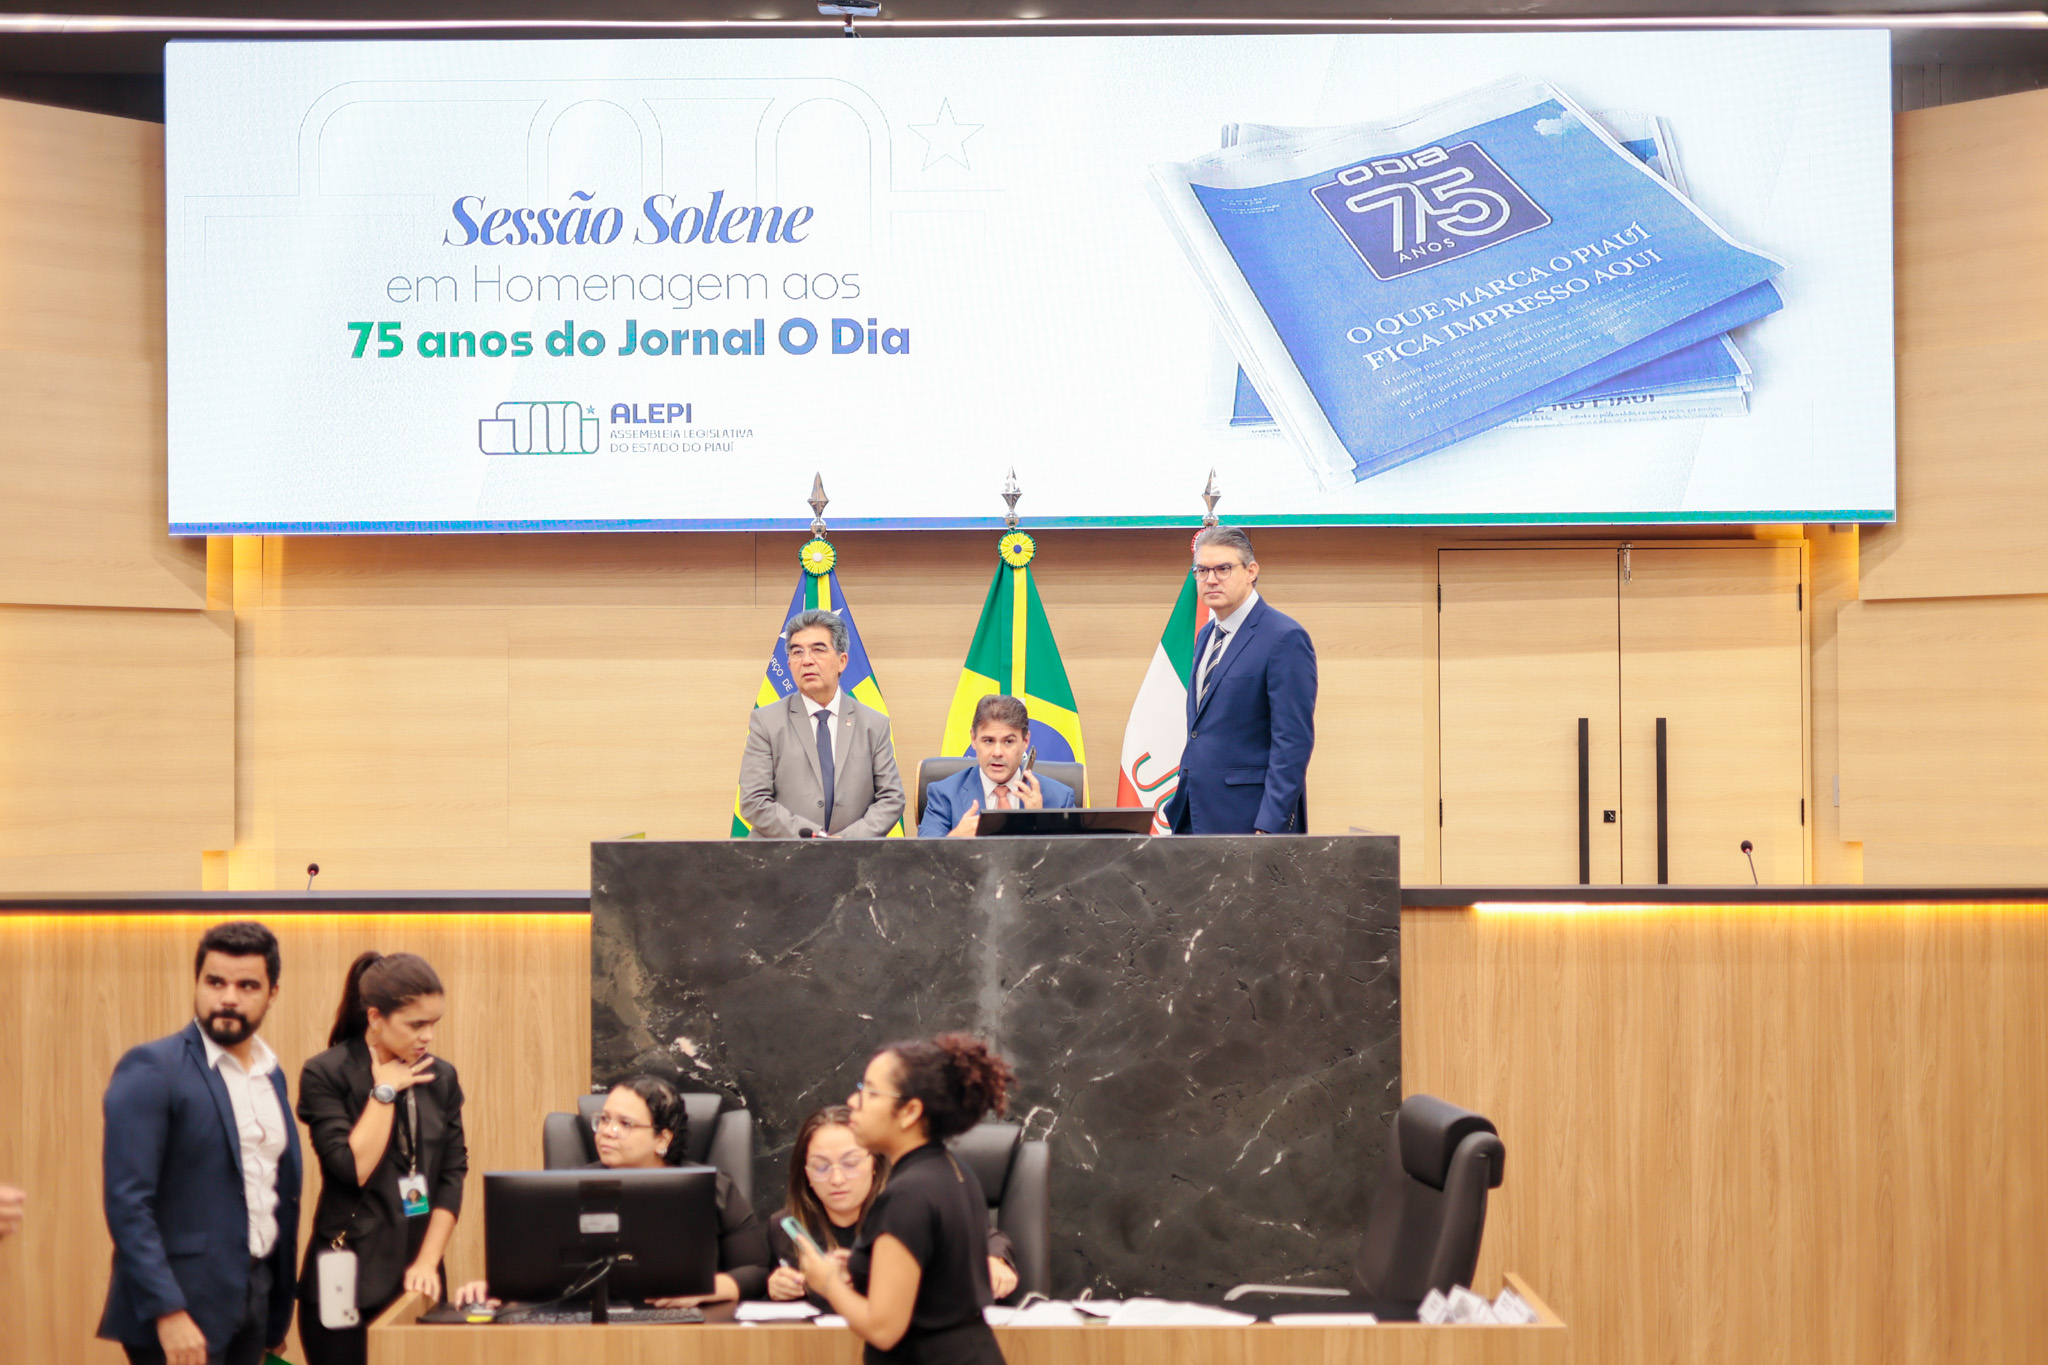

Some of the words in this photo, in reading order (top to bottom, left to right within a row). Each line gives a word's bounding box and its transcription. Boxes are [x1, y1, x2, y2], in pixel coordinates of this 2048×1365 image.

[442, 191, 623, 246] Sessão
[633, 190, 813, 244] Solene
[1345, 166, 1511, 252] 75
[1399, 237, 1457, 263] ANOS
[387, 276, 457, 303] em
[475, 265, 767, 309] Homenagem
[783, 272, 860, 300] aos
[1346, 327, 1373, 344] O
[1375, 301, 1446, 335] QUE
[1442, 266, 1554, 311] MARCA
[1549, 256, 1573, 272] O
[1570, 220, 1653, 264] PIAUÍ
[1362, 333, 1445, 370] FICA
[1441, 277, 1590, 340] IMPRESSO
[1593, 248, 1664, 285] AQUI
[348, 322, 403, 358] 75
[417, 331, 533, 358] anos
[546, 320, 605, 356] do
[619, 319, 764, 356] Jornal
[779, 318, 818, 355] O
[832, 318, 909, 354] Dia
[1392, 368, 1422, 381] tempo
[1468, 341, 1489, 353] pode
[1408, 405, 1431, 420] para
[1432, 397, 1449, 409] que
[1459, 376, 1500, 397] memória
[1501, 371, 1513, 379] do
[1514, 359, 1540, 374] nosso
[1540, 350, 1562, 363] povo
[1414, 391, 1428, 401] ser
[1438, 371, 1479, 392] guardião
[1480, 366, 1492, 374] da
[610, 403, 691, 423] ALEPI
[610, 429, 680, 439] ASSEMBLEIA
[683, 429, 754, 438] LEGISLATIVA
[610, 443, 629, 453] DO
[632, 442, 678, 453] ESTADO
[682, 442, 702, 453] DO
[704, 441, 734, 452] PIAUÍ
[770, 654, 784, 677] RÇO
[782, 678, 794, 692] DE
